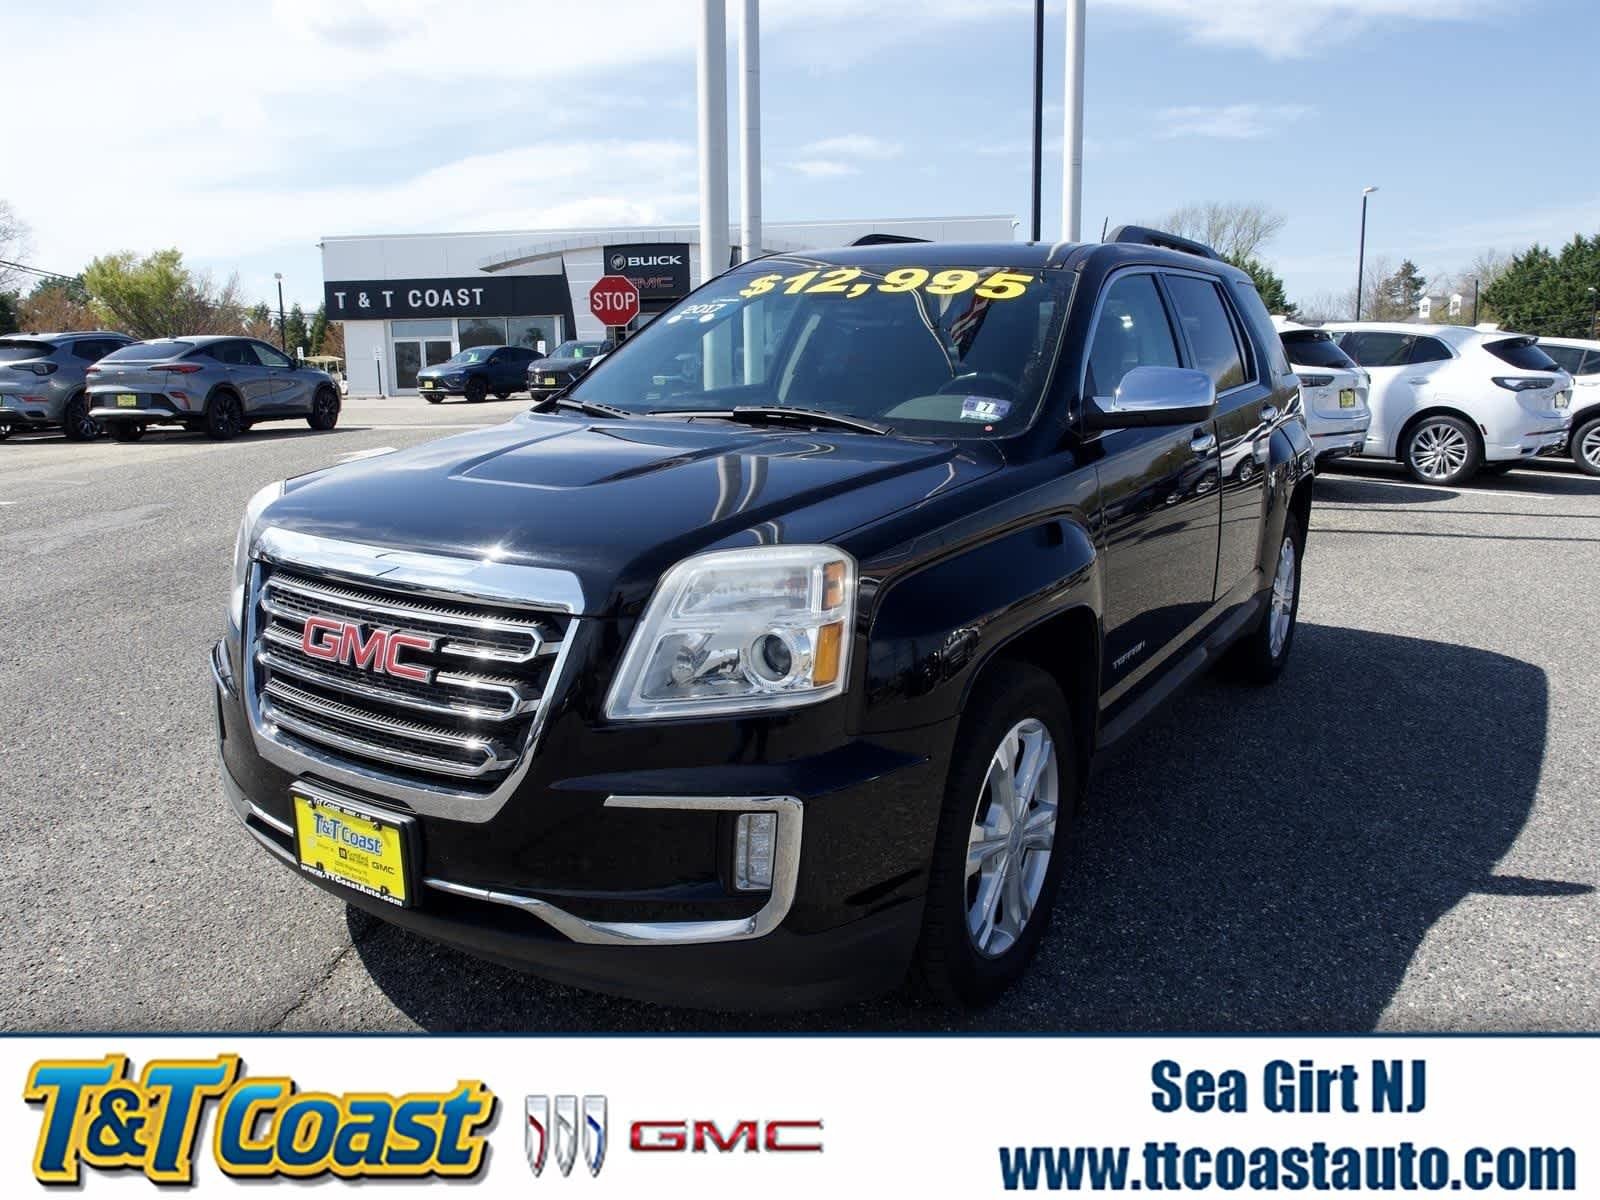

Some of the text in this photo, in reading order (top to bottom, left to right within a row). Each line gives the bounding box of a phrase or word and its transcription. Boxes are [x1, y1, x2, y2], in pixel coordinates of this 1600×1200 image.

[628, 256, 682, 265] BUICK
[740, 268, 1034, 299] $12,995
[334, 288, 484, 309] T & T COAST
[593, 292, 636, 311] STOP
[680, 303, 727, 315] 2017
[303, 616, 436, 684] GMC
[314, 814, 341, 840] T&T
[341, 826, 383, 856] Coast
[372, 861, 395, 875] GMC
